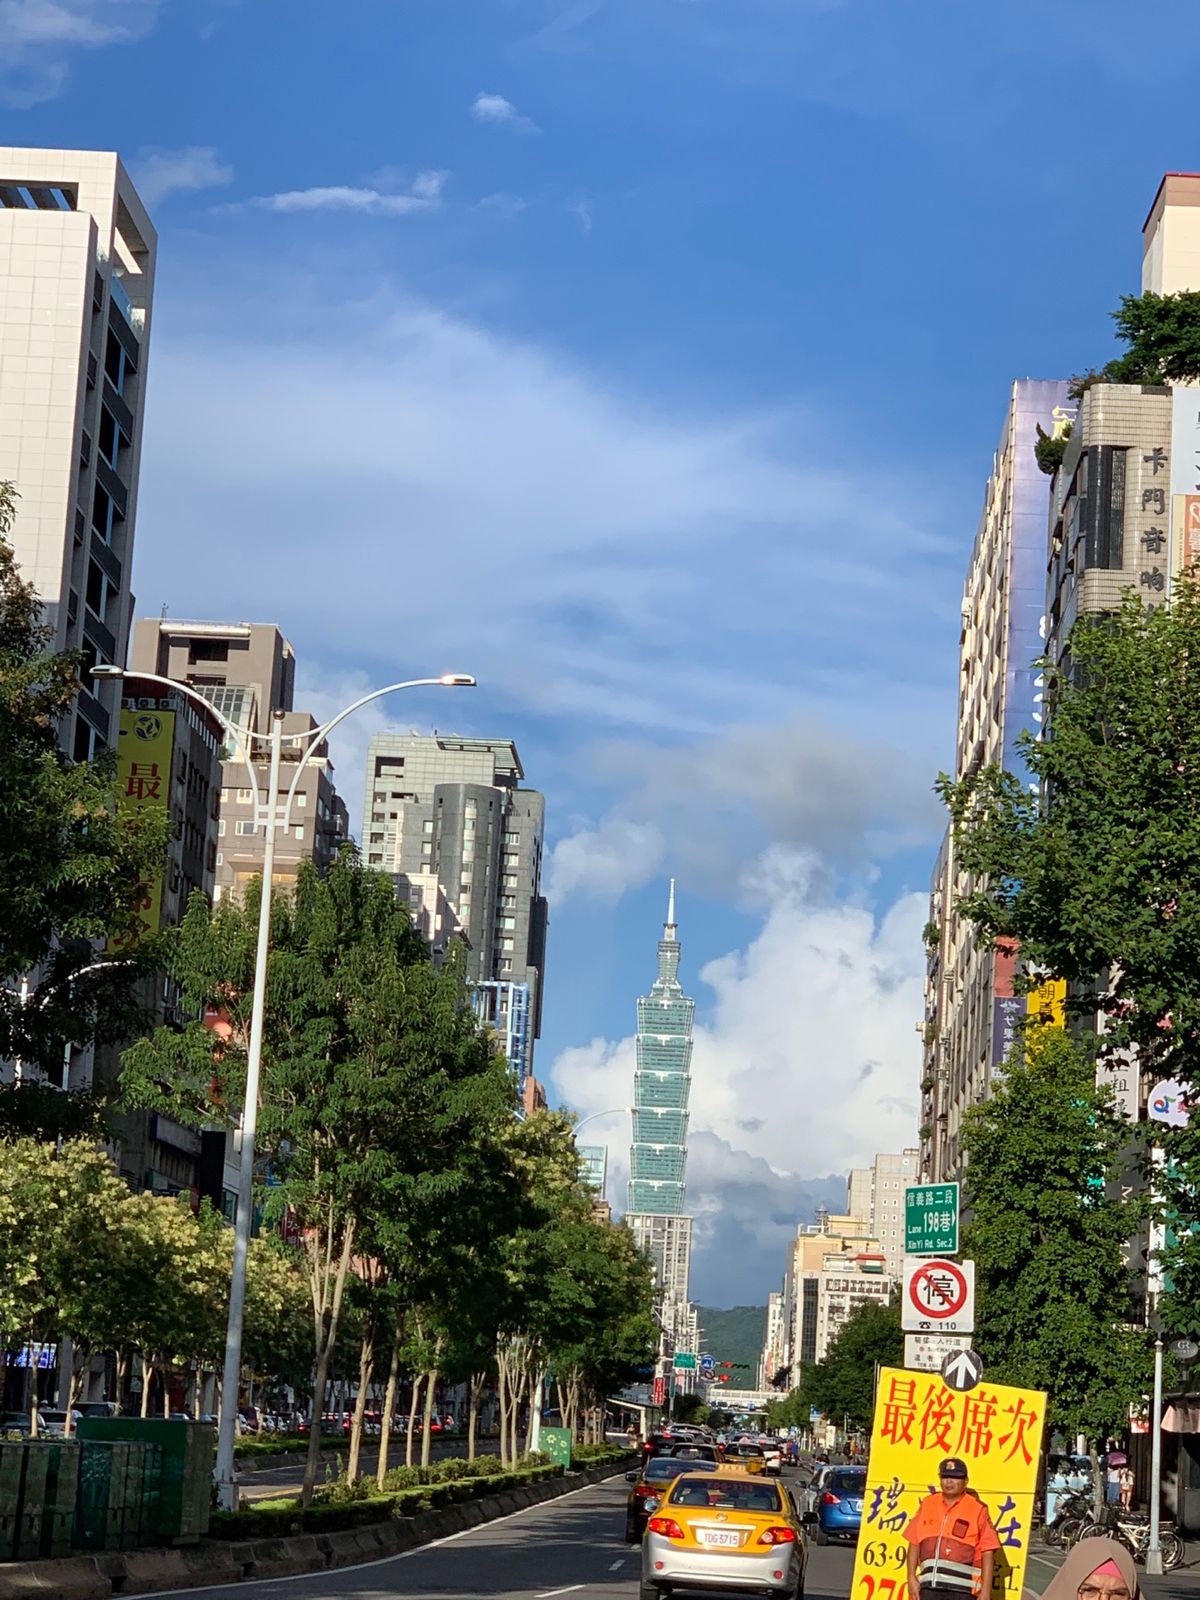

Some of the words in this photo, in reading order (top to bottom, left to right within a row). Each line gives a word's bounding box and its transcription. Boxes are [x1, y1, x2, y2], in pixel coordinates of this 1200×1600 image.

[907, 1189, 953, 1207] 信義路二段
[908, 1225, 922, 1234] Lane
[924, 1239, 934, 1248] Rd.
[923, 1274, 954, 1306] 停
[938, 1322, 957, 1330] 110
[881, 1378, 1038, 1466] 最後席次
